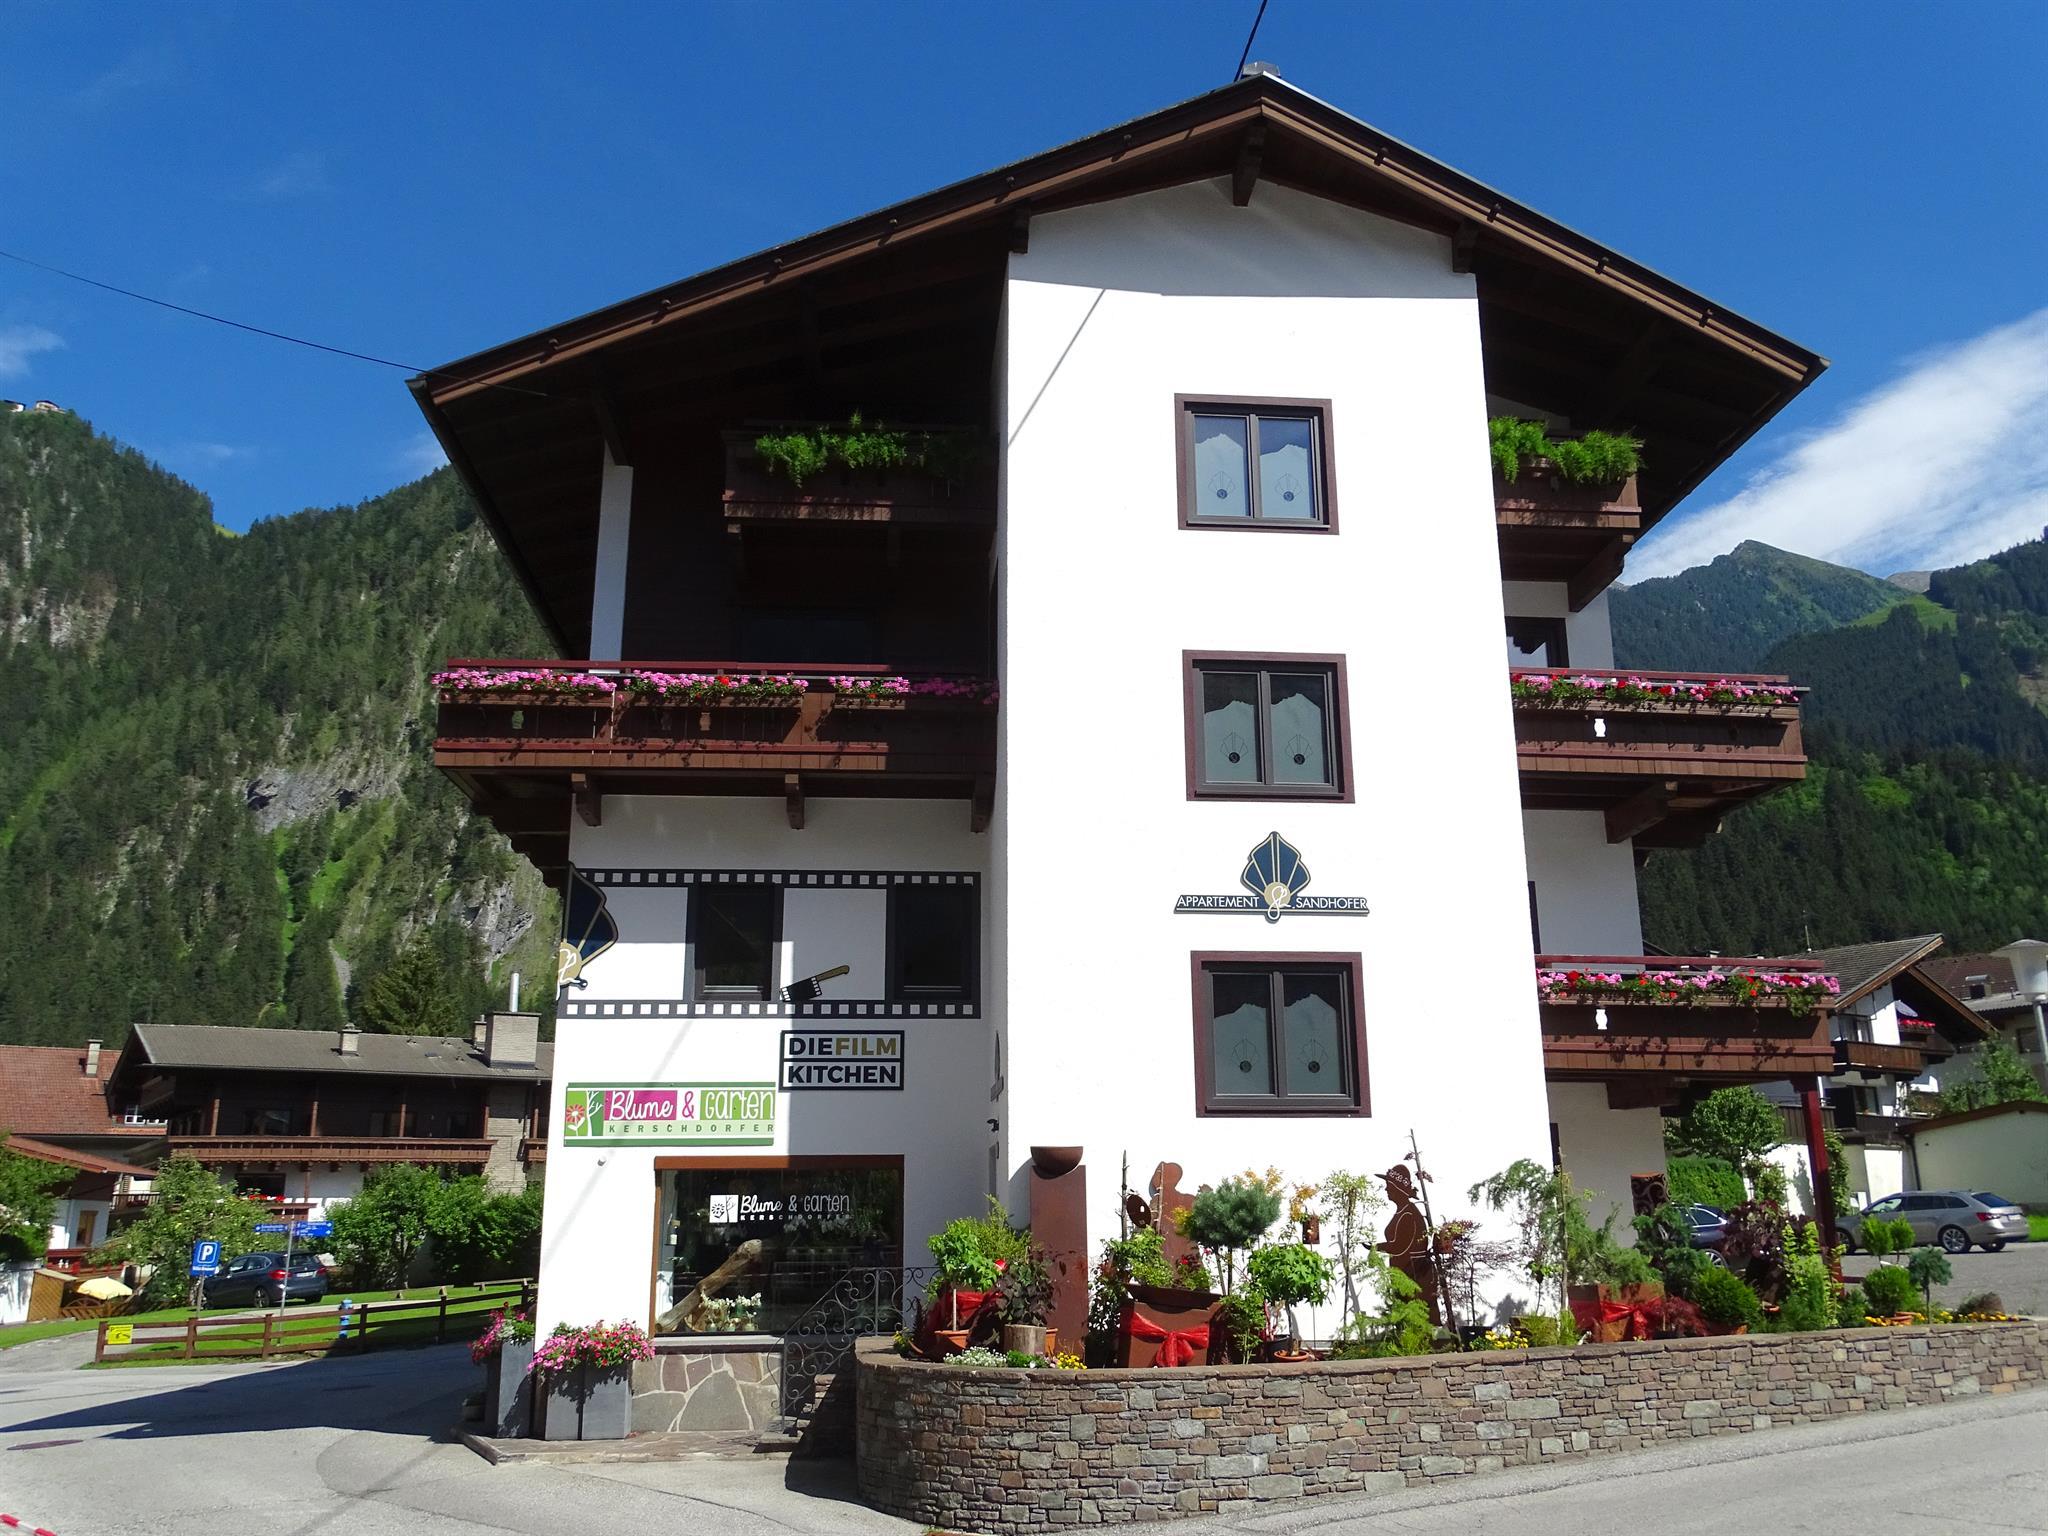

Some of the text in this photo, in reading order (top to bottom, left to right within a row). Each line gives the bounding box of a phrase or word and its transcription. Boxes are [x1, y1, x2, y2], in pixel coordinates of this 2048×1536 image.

[1177, 896, 1367, 909] APPARTEMENT SANDHOFER
[788, 1065, 897, 1083] KITCHEN
[608, 1091, 674, 1120] Blume
[682, 1090, 695, 1119] &
[609, 1124, 774, 1133] KERSCHDORFER
[740, 1195, 783, 1213] Blume
[788, 1195, 798, 1212] &
[202, 1245, 213, 1260] P
